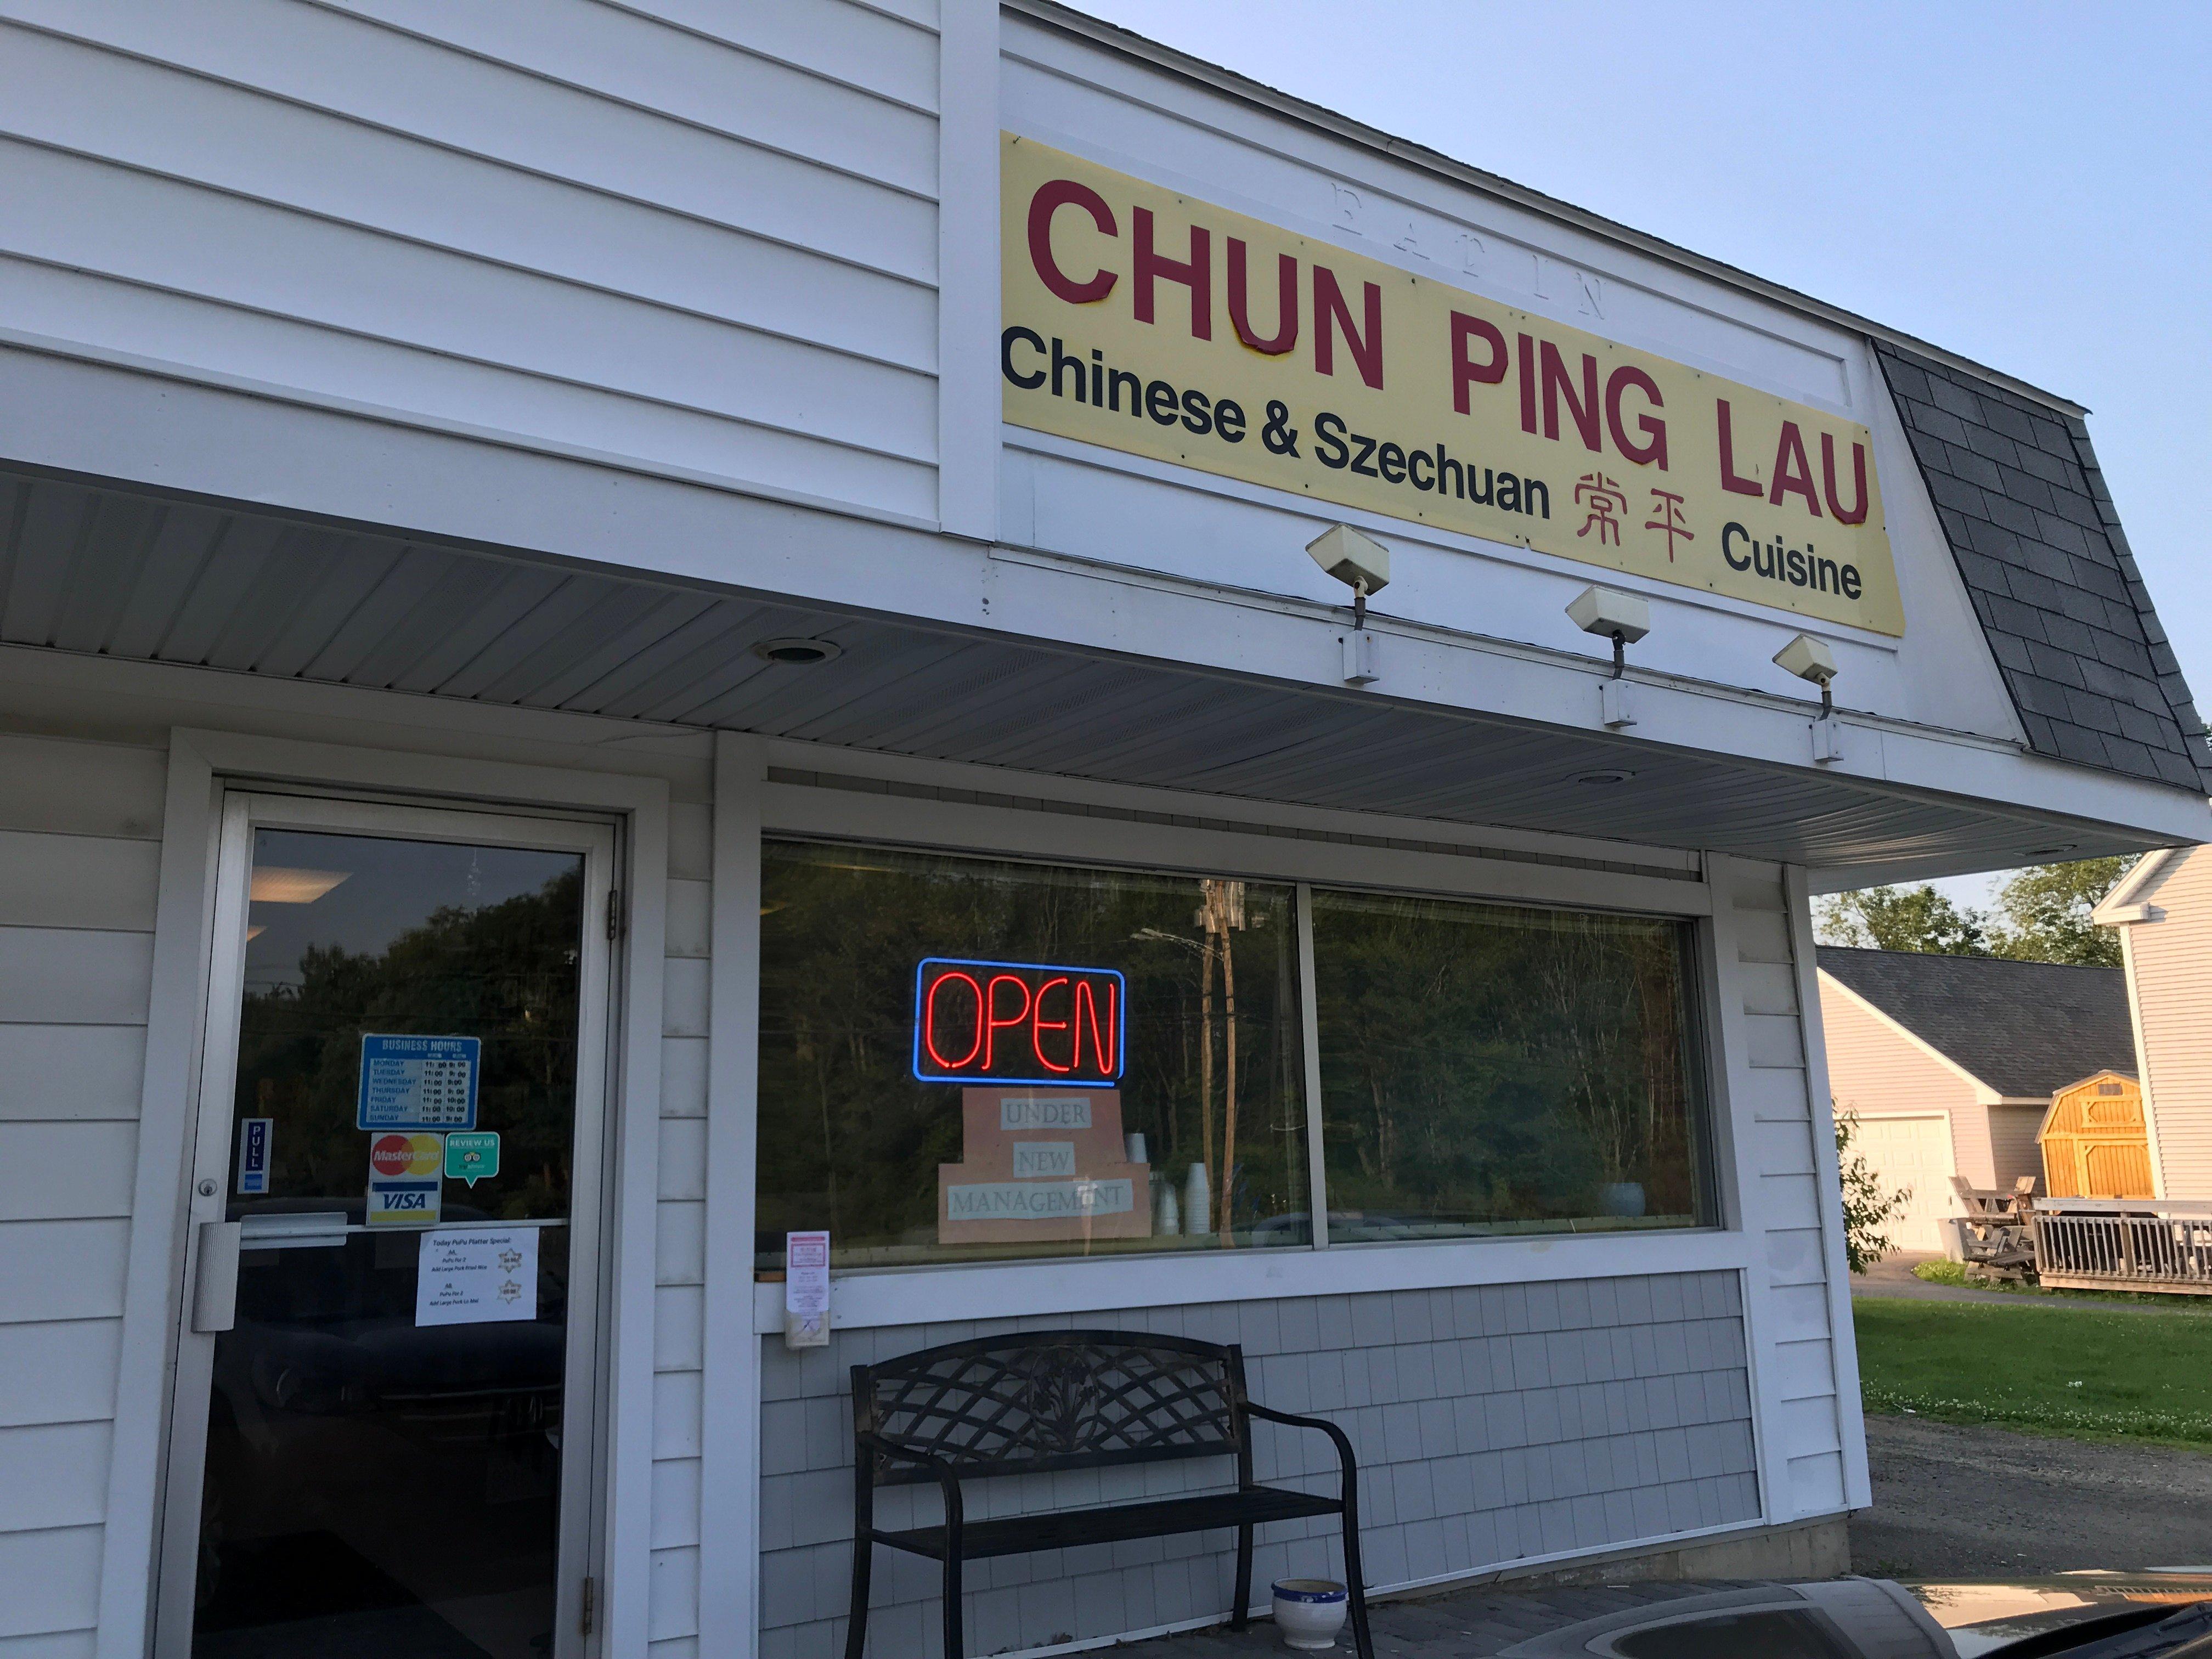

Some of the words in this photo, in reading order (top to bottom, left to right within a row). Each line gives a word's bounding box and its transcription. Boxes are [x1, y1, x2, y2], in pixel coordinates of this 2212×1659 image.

[1028, 179, 1384, 390] CHUN
[1451, 310, 1669, 471] PING
[1717, 398, 1868, 524] LAU
[1001, 326, 1246, 443] Chinese
[1262, 400, 1300, 459] &
[1314, 413, 1550, 520] Szechuan
[1722, 522, 1861, 600] Cuisine
[926, 971, 1115, 1075] OPEN
[382, 1040, 428, 1051] BUSINESS
[431, 1041, 462, 1052] HOURS
[1006, 1104, 1086, 1124] UNDER
[251, 1125, 261, 1167] PULL
[374, 1151, 439, 1162] MasterCard
[1018, 1152, 1070, 1172] NEW
[383, 1193, 426, 1210] VISA
